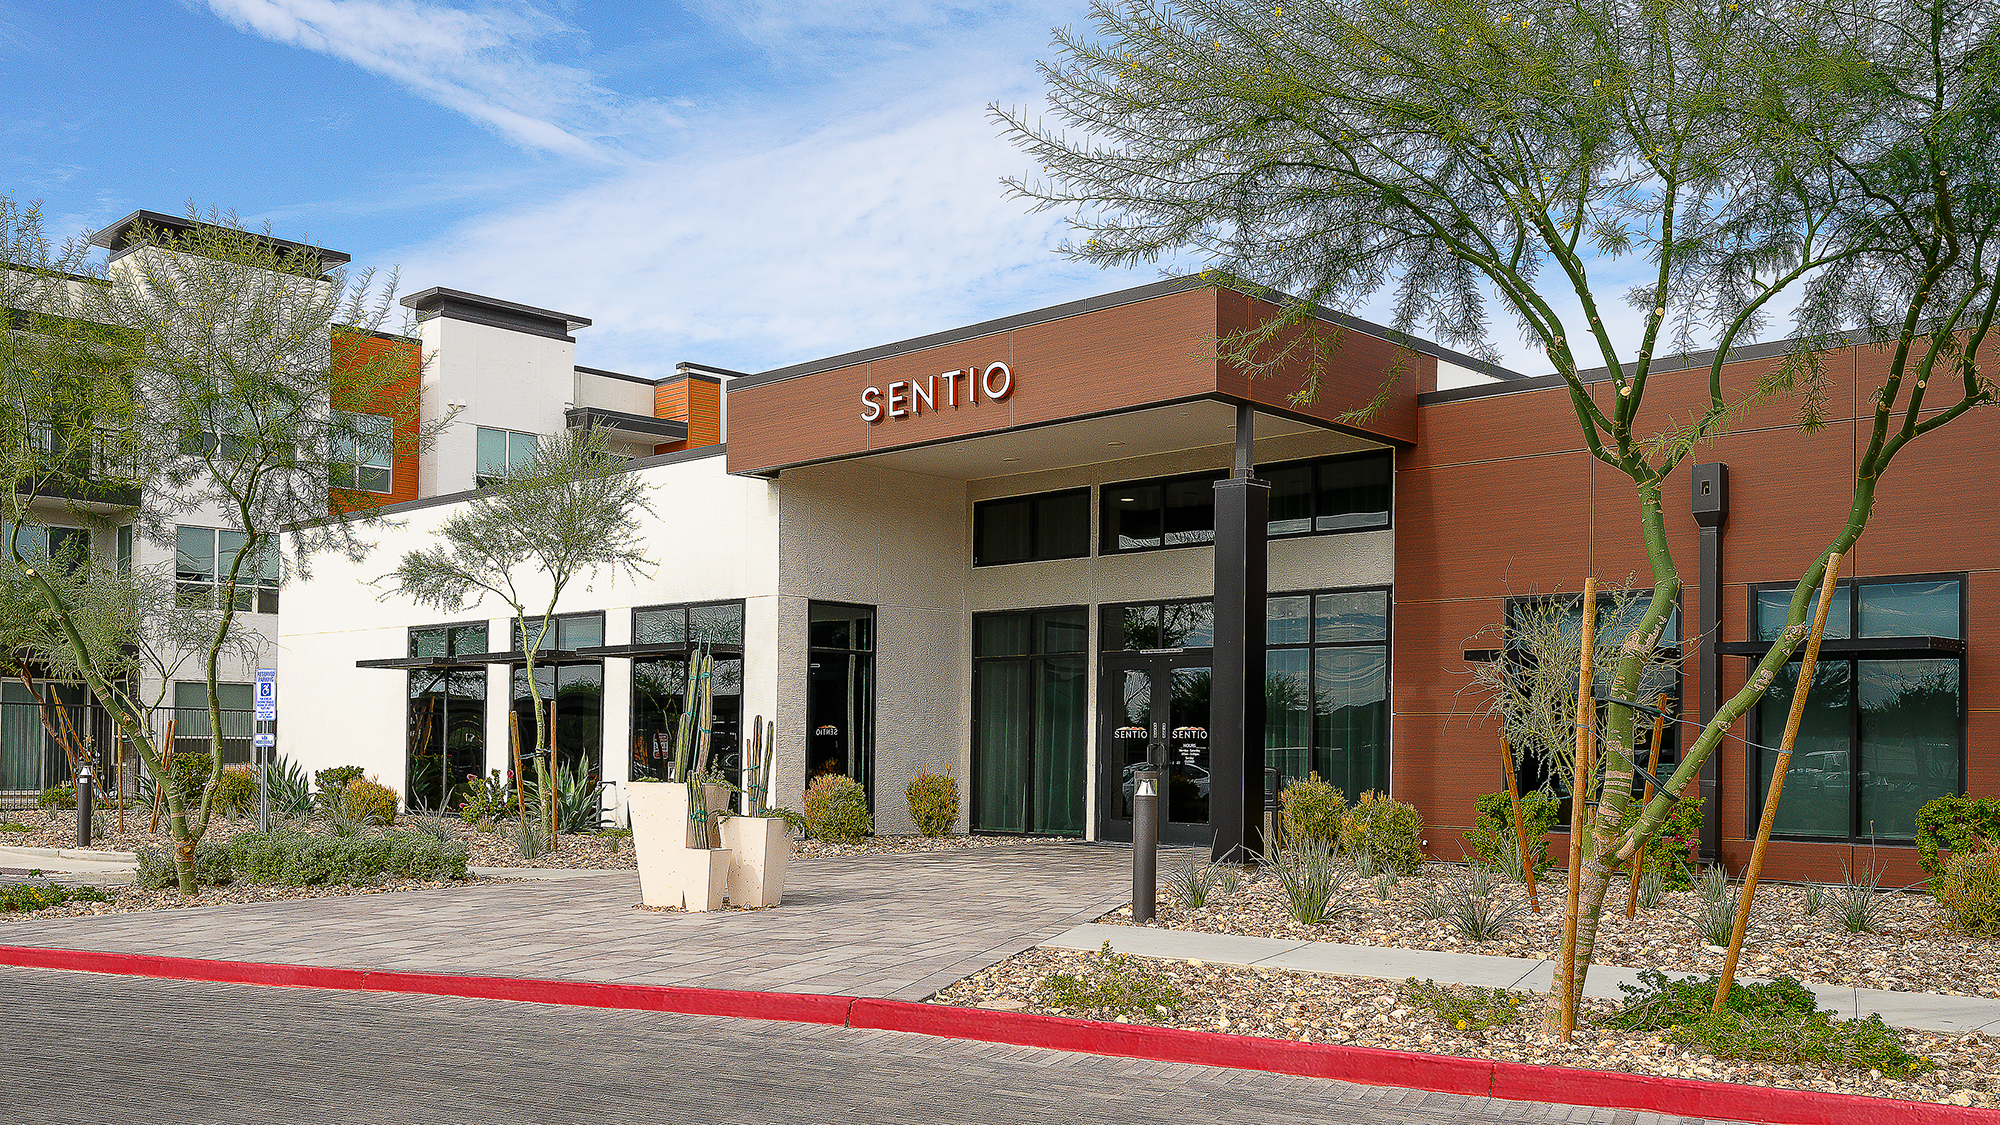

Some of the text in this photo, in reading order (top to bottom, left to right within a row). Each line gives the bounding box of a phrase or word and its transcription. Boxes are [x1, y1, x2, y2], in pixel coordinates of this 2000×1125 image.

[860, 360, 1015, 424] SENTIO
[1114, 730, 1148, 739] SENTIO
[1172, 730, 1208, 739] SENTIO
